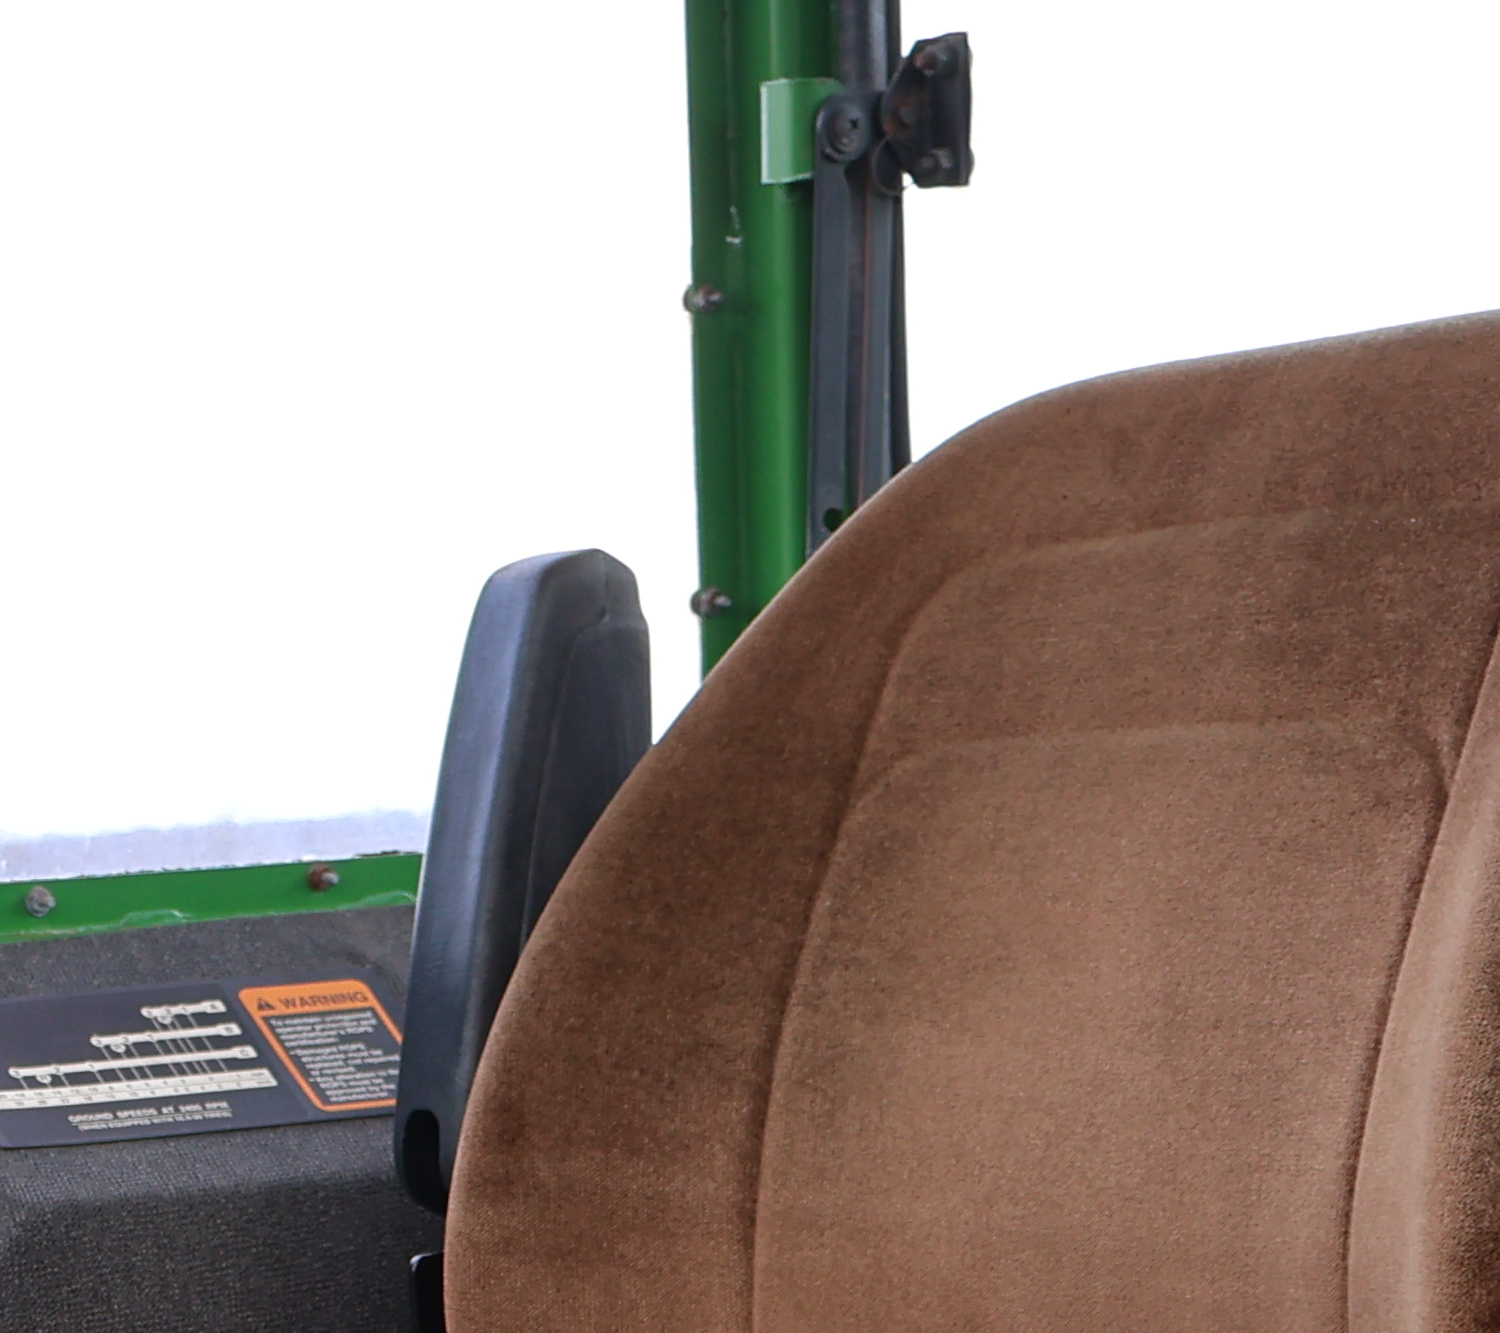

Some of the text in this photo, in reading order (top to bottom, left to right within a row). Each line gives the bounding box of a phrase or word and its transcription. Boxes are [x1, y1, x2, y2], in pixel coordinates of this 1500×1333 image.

[279, 991, 369, 1009] WARNING
[67, 1111, 114, 1124] GROUND
[115, 1106, 158, 1119] SPEEDS
[161, 1104, 175, 1115] AT
[204, 1100, 230, 1111] RPM
